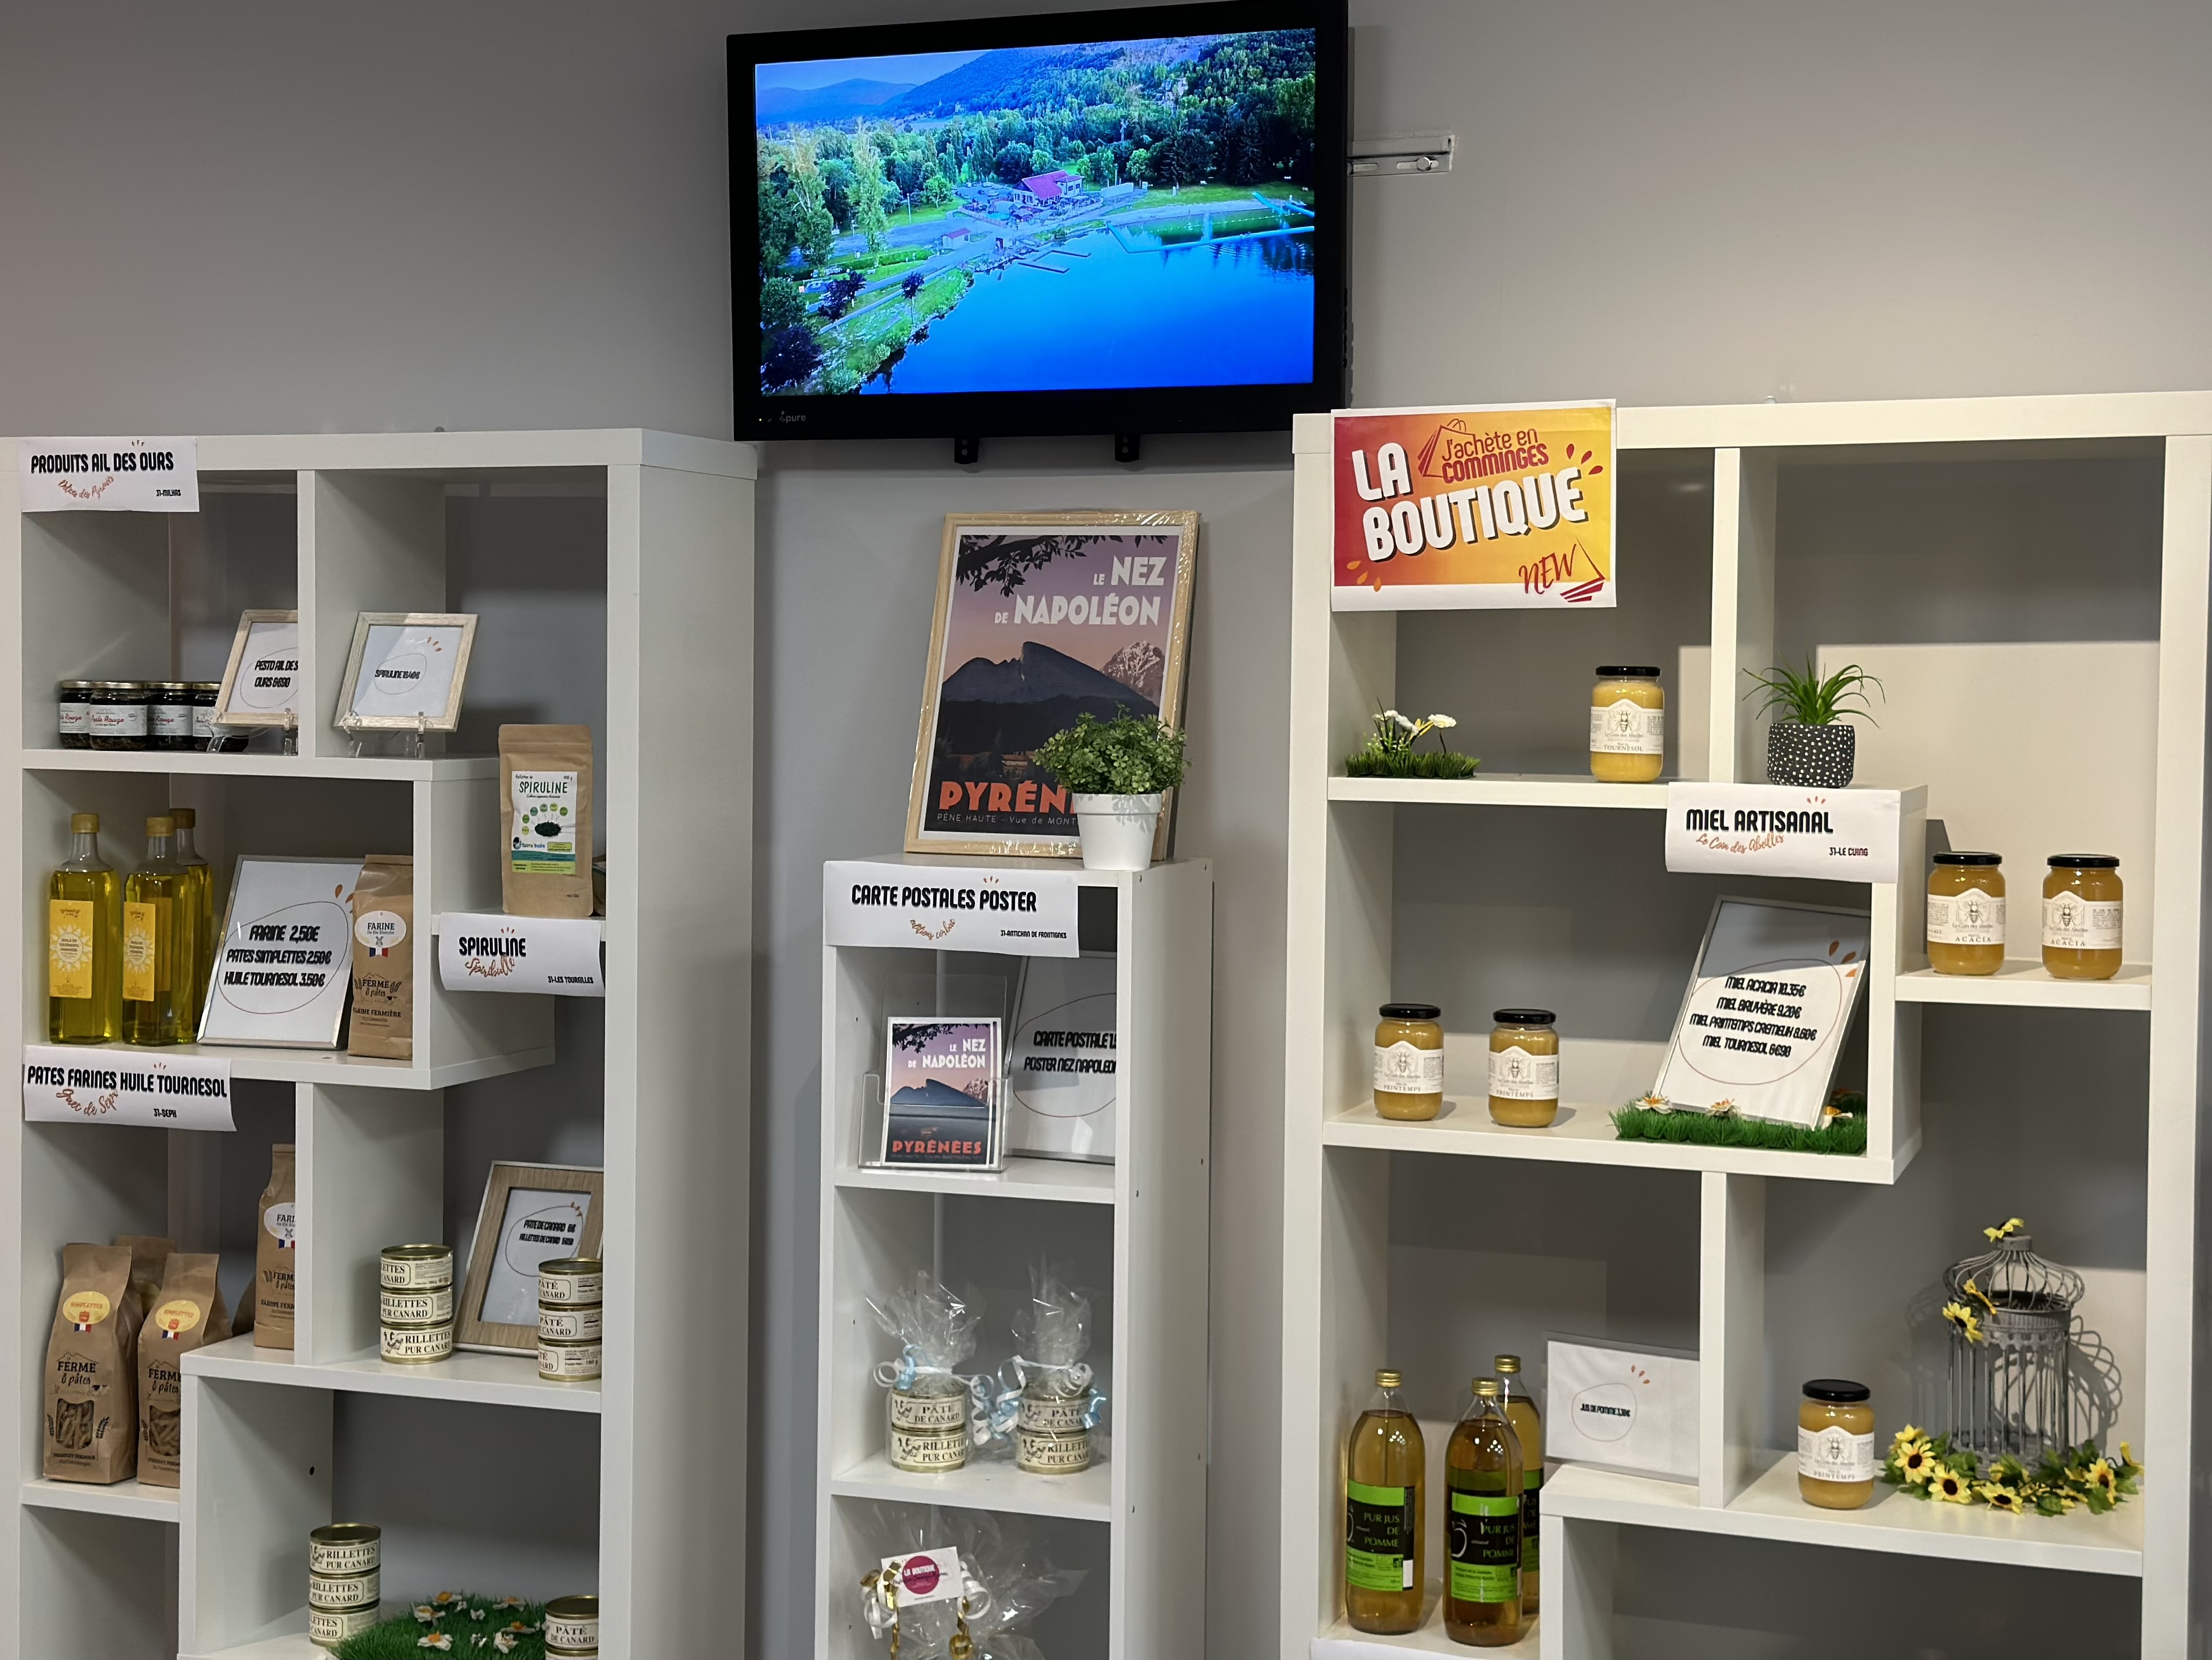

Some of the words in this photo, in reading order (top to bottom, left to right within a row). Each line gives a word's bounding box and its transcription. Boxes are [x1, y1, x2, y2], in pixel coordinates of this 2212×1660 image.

[1442, 430, 1512, 462] J'achète
[1516, 428, 1539, 446] en
[31, 454, 89, 473] PRODUITS
[92, 453, 110, 472] AIL
[114, 452, 136, 471] DES
[140, 452, 173, 470] OURS
[1442, 443, 1550, 484] COMMINGES
[1351, 442, 1413, 502] LA
[156, 489, 181, 497] 31-MILHAS
[1362, 466, 1588, 562] BOUTIQUE
[1093, 574, 1105, 586] LE
[1111, 555, 1167, 587] NEZ
[1518, 543, 1578, 595] NEW
[995, 612, 1009, 624] DE
[1014, 593, 1161, 626] NAPOLÉON
[254, 660, 275, 671] PESTO
[285, 660, 299, 671] DES
[375, 670, 403, 678] SPIRULINE
[254, 677, 273, 687] OURS
[519, 782, 568, 794] SPIRULINE
[938, 780, 1075, 814] PYRÉN
[966, 815, 996, 823] HAUTE
[1032, 816, 1043, 824] de
[1686, 809, 1729, 831] MIEL
[1734, 811, 1833, 834] ARTISANAL
[1730, 841, 1747, 854] des
[1829, 847, 1846, 856] 31-LE
[852, 884, 898, 906] CARTE
[902, 887, 975, 909] POSTALES
[980, 890, 1037, 912] POSTER
[249, 925, 287, 941] FARINE
[368, 922, 395, 931] FARINE
[459, 936, 526, 957] SPIRULINE
[226, 949, 255, 962] PATES
[254, 950, 307, 964] SIMPLETTES
[224, 971, 250, 985] HUILE
[250, 972, 298, 986] TOURNESOL
[362, 979, 390, 988] FERME
[1725, 976, 1745, 990] MIEL
[1745, 979, 1778, 994] ACACIA
[370, 988, 385, 997] pâtes
[1716, 997, 1737, 1010] MIEL
[1737, 998, 1778, 1016] BRUYÈRE
[1689, 1013, 1708, 1026] MIEL
[1709, 1016, 1755, 1033] PRINTEMPS
[1754, 1022, 1795, 1038] CREMEUX
[949, 1044, 957, 1052] LE
[962, 1038, 986, 1052] NEZ
[1034, 1031, 1065, 1047] CARTE
[1065, 1031, 1109, 1048] POSTALE
[1702, 1035, 1722, 1048] MIEL
[1725, 1037, 1767, 1055] TOURNESOL
[923, 1054, 985, 1069] NAPOLÉON
[1024, 1056, 1057, 1071] POSTER
[1057, 1058, 1075, 1071] NEZ
[27, 1065, 65, 1086] PATES
[67, 1069, 117, 1090] FARINES
[120, 1072, 154, 1092] HUILE
[157, 1074, 227, 1098] TOURNESOL
[84, 1102, 97, 1116] de
[892, 1139, 982, 1154] PYRÉNÉES
[523, 1219, 537, 1229] PATE
[261, 1299, 279, 1309] FARINE
[383, 1298, 428, 1308] RILLETTES
[394, 1310, 428, 1318] CANARD
[540, 1316, 563, 1327] PÂTÉ
[406, 1331, 450, 1344] RILLETTES
[542, 1327, 571, 1336] CANARD
[405, 1346, 422, 1354] PUR
[424, 1341, 450, 1353] CANARD
[57, 1361, 96, 1373] FERME
[68, 1373, 91, 1386] pâtes
[158, 1381, 179, 1394] pâtes
[928, 1413, 960, 1422] CANARD
[923, 1454, 940, 1462] PUR
[1814, 1470, 1855, 1480] PRINTEMPS
[1363, 1512, 1382, 1523] PUR
[1384, 1513, 1400, 1524] JUS
[1387, 1526, 1399, 1535] DE
[1483, 1524, 1501, 1535] PUR
[1365, 1537, 1399, 1548] POMME
[326, 1547, 374, 1559] RILLETTES
[345, 1556, 374, 1568] CANARD
[312, 1581, 358, 1593] RILLETTES
[325, 1594, 359, 1602] CANARD
